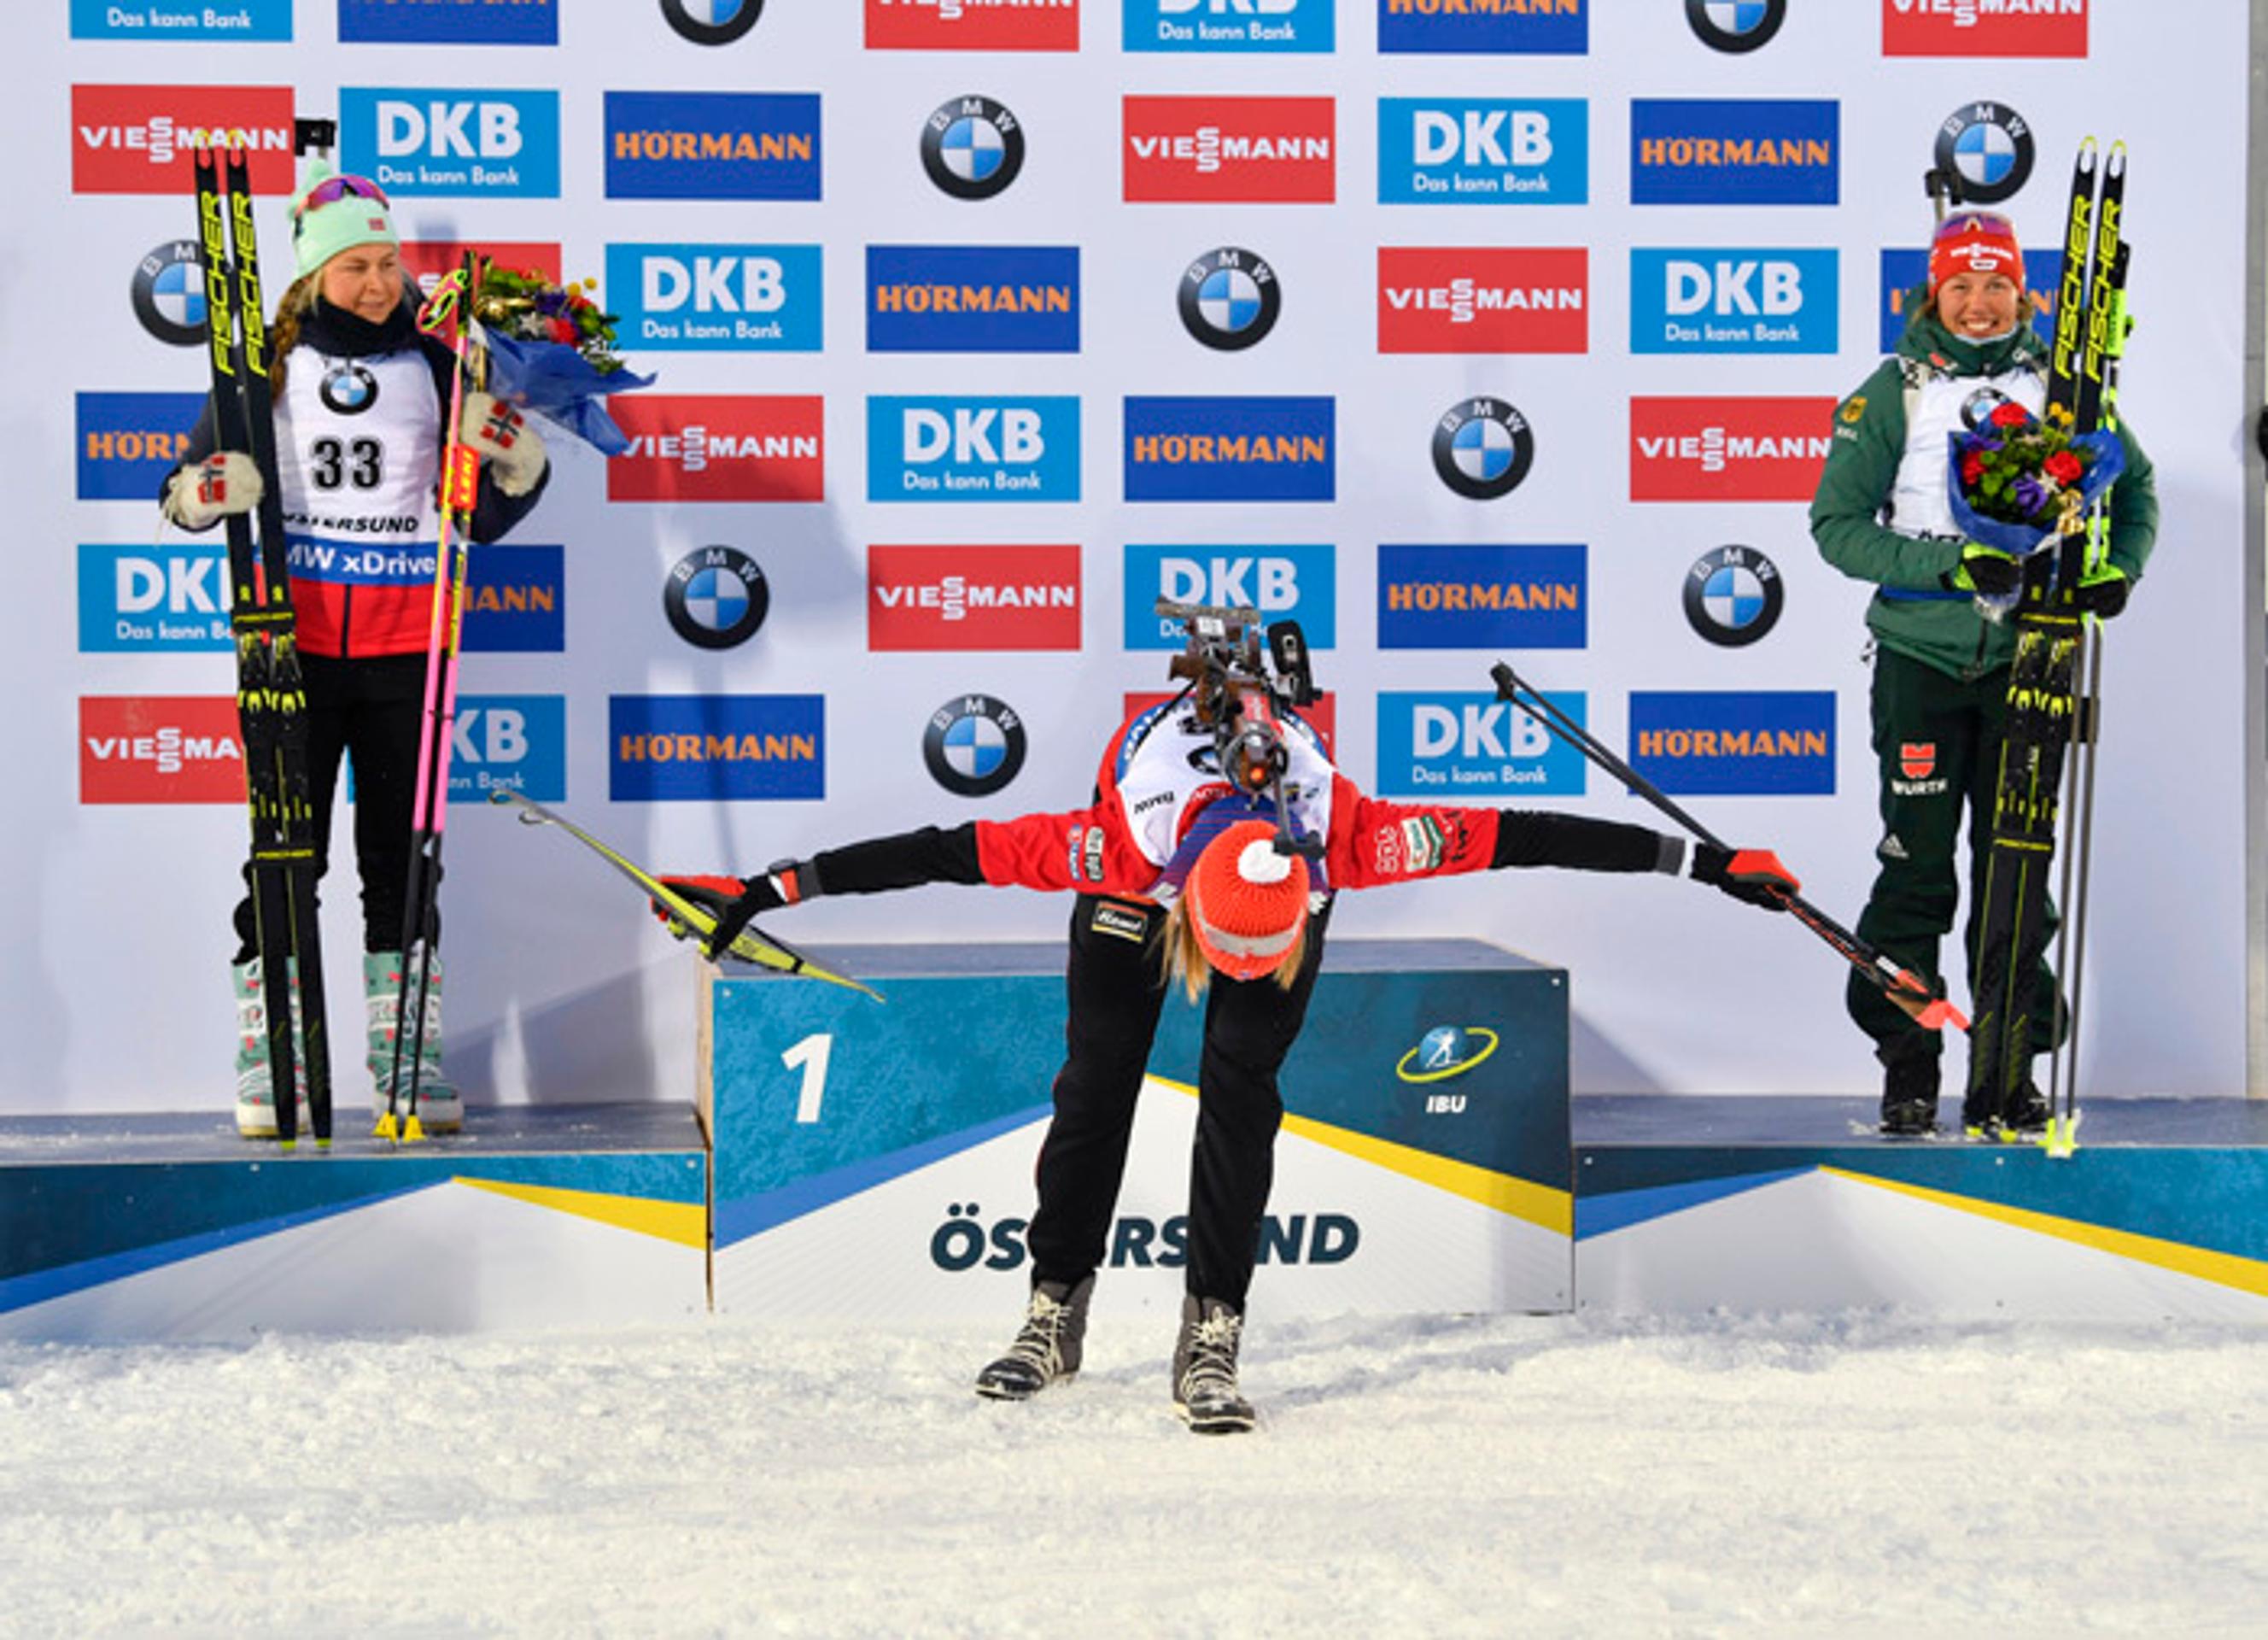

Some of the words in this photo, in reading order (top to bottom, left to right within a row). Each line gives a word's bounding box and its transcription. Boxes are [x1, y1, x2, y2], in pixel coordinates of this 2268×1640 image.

[108, 8, 144, 26] Das
[150, 9, 197, 26] kann
[203, 9, 250, 27] Bank
[1894, 0, 2082, 26] VIESMANN
[1159, 21, 1193, 39] Das
[1200, 21, 1244, 39] kann
[1250, 22, 1295, 39] Bank
[377, 102, 522, 157] DKB
[931, 98, 1015, 132] BMW
[1944, 105, 2026, 138] BMW
[80, 117, 287, 162] VIESSMANN
[616, 128, 810, 160] HÖRMANN
[1131, 127, 1329, 172] VIESSMANN
[1414, 111, 1552, 165] DKB
[1641, 136, 1828, 165] HÖRMANN
[378, 166, 414, 184] Das
[420, 167, 466, 184] kann
[471, 167, 519, 185] Bank
[1414, 173, 1448, 191] Das
[1454, 173, 1498, 191] kann
[1504, 173, 1549, 191] Bank
[201, 190, 235, 375] FISCHER
[232, 190, 267, 377] FISCHER
[643, 257, 786, 311] DKB
[1189, 251, 1271, 284] BMW
[878, 282, 1069, 312] HÖRMANN
[1387, 279, 1581, 322] VIESSMANN
[1666, 261, 1803, 314] DKB
[2054, 195, 2092, 380] FISCHER
[2084, 197, 2121, 383] FISCHER
[643, 319, 678, 337] Das
[685, 321, 730, 337] kann
[736, 320, 782, 338] Bank
[1666, 324, 1699, 341] Das
[1705, 325, 1749, 341] kann
[1755, 324, 1799, 341] Bank
[1442, 401, 1526, 433] BMW
[903, 409, 1044, 463] DKB
[1135, 431, 1324, 462] HÖRMANN
[1638, 428, 1831, 472] VIESSMANN
[313, 438, 382, 489] 33
[903, 471, 938, 489] Das
[944, 472, 990, 489] kann
[996, 471, 1041, 489] Bank
[342, 550, 437, 576] xDrive
[675, 548, 759, 582] BMW
[1692, 549, 1774, 581] BMW
[878, 577, 1074, 619] VIESSMANN
[1160, 558, 1300, 611] DKB
[1389, 580, 1576, 610] HÖRMANN
[117, 621, 152, 639] Das
[159, 621, 205, 639] kann
[935, 697, 1015, 730] BMW
[452, 709, 528, 763] KB
[622, 731, 814, 761] HÖRMANN
[1413, 705, 1552, 758] DKB
[1640, 726, 1826, 756] HÖRMANN
[89, 729, 241, 772] VIESSMA
[1412, 765, 1447, 783] Das
[1453, 766, 1496, 783] kann
[1502, 765, 1547, 783] Bank
[781, 1033, 833, 1123] 1
[1425, 1096, 1466, 1114] IBU
[931, 1203, 1359, 1271] ÖSRSND
